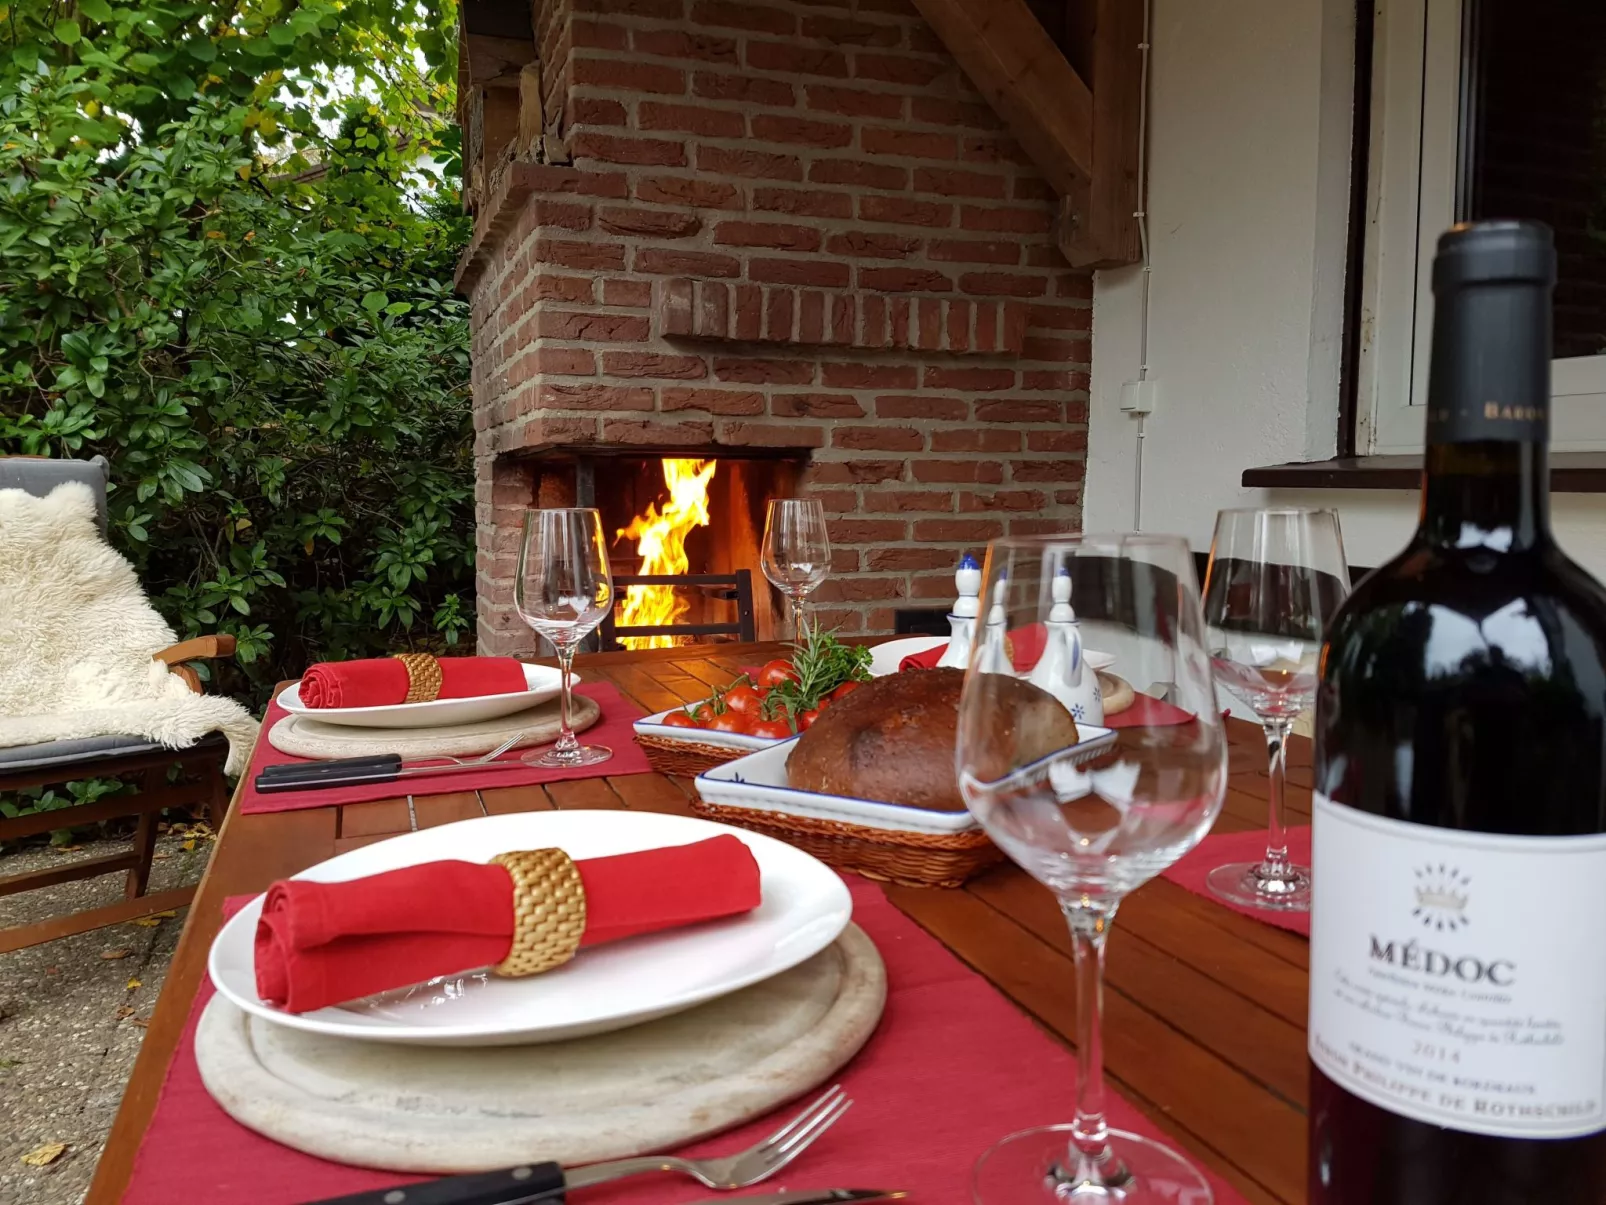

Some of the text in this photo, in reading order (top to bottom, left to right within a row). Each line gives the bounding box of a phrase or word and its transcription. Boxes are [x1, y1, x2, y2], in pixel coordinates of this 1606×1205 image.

[1368, 933, 1516, 988] MÉDOC
[1412, 1040, 1461, 1065] 2014
[1437, 1092, 1465, 1111] DE
